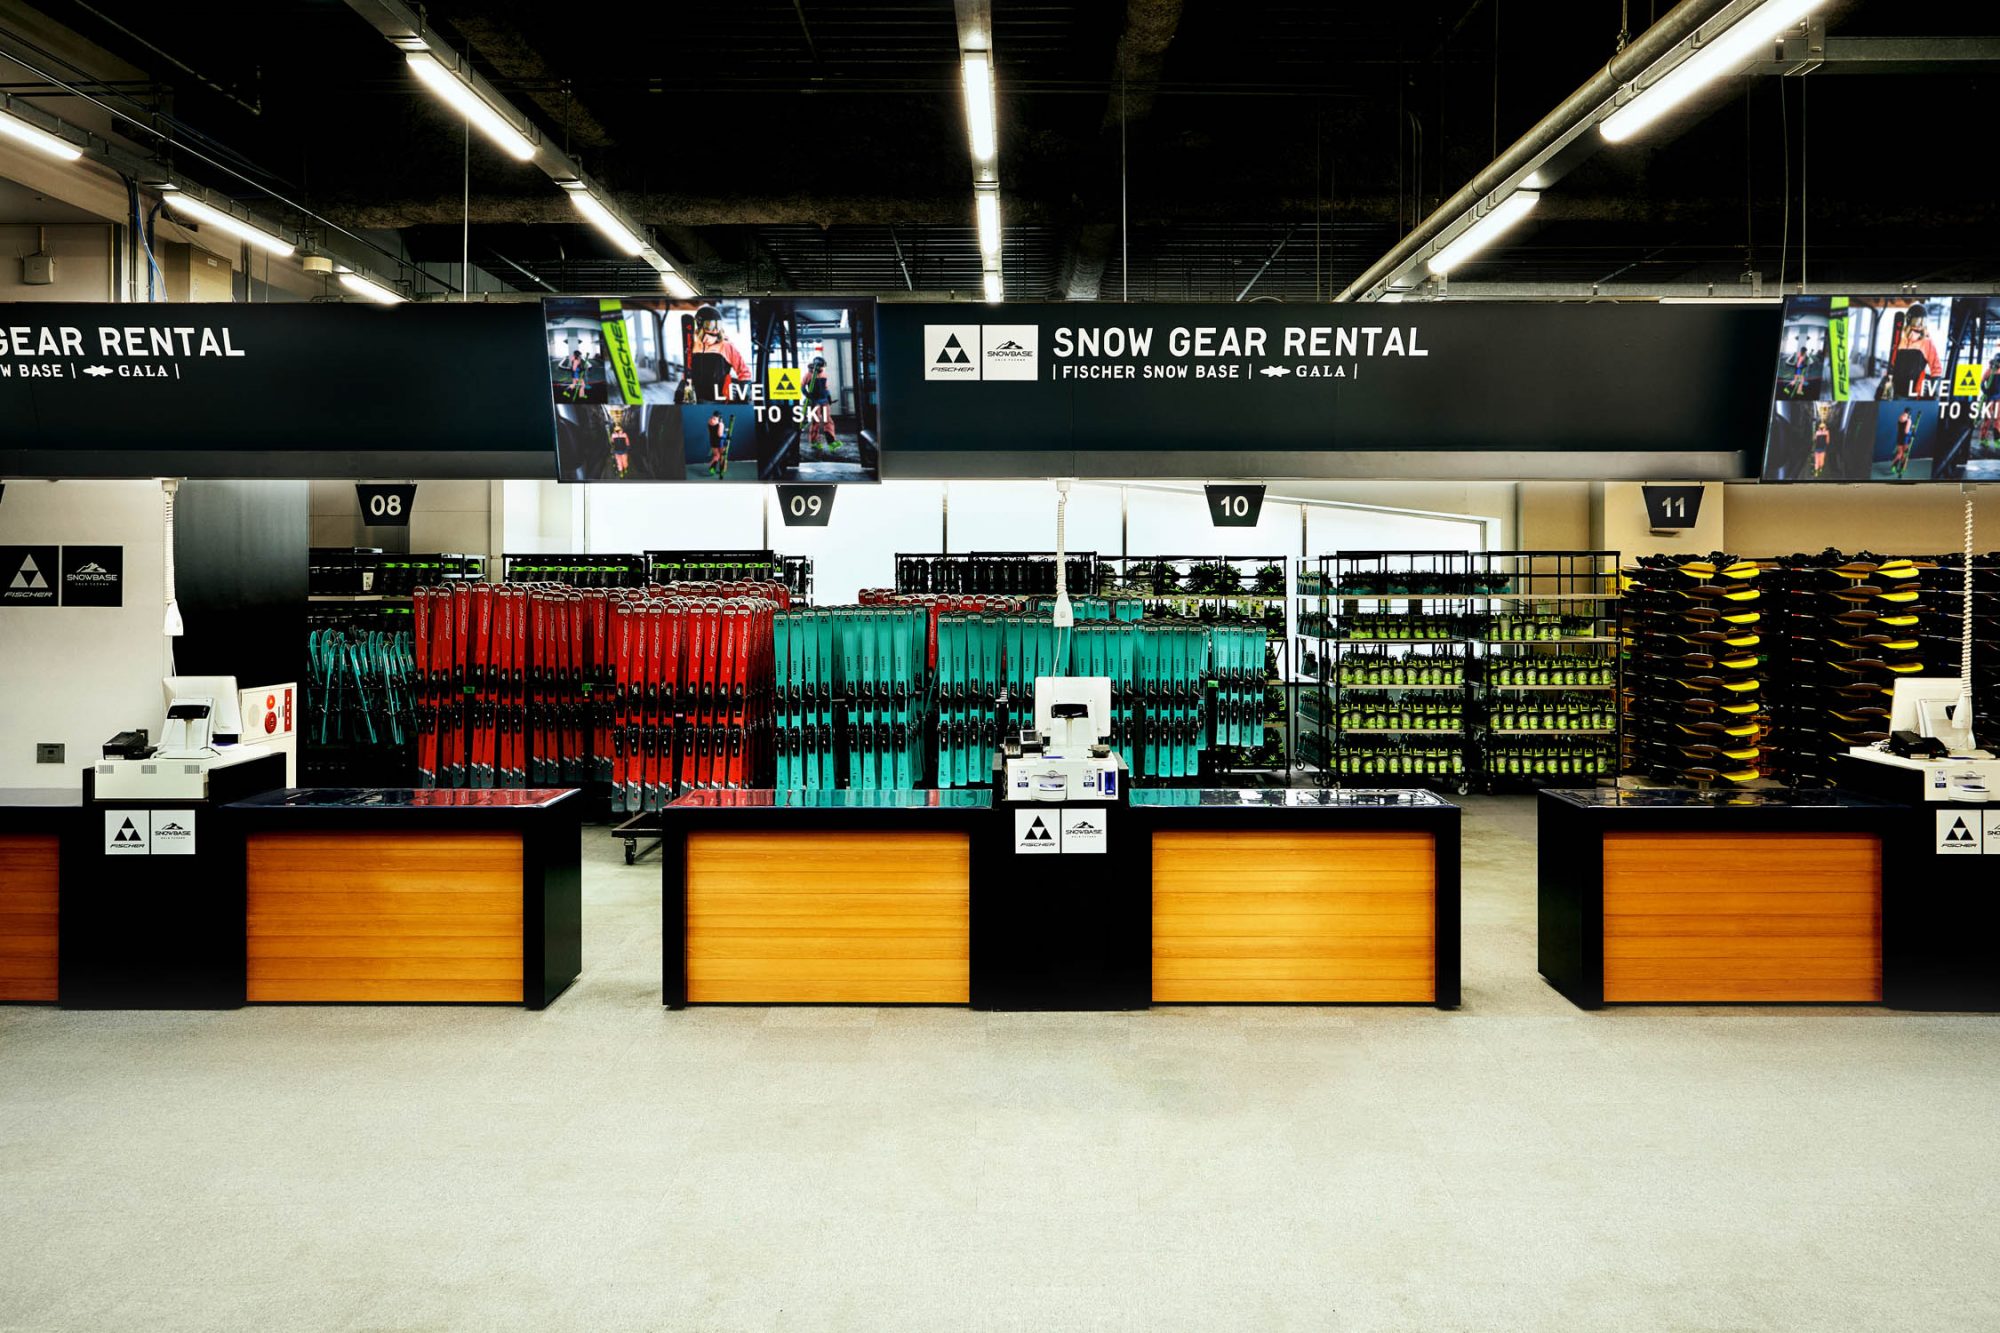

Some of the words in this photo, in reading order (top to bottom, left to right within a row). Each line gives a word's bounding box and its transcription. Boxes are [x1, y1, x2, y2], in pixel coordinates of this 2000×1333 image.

[98, 326, 246, 357] RENTAL
[1052, 326, 1154, 358] SNOW
[1168, 326, 1268, 357] GEAR
[1283, 326, 1429, 357] RENTAL
[986, 350, 1033, 358] SNOWBASE
[18, 363, 64, 378] BASE
[118, 364, 169, 377] GALA
[1062, 364, 1136, 379] FISCHER
[1142, 364, 1189, 379] SNOW
[1195, 364, 1240, 379] BASE
[1295, 364, 1346, 378] GALA
[714, 383, 765, 401] LIVE
[1908, 379, 1951, 397] LIVE
[753, 405, 782, 423] TO
[792, 405, 828, 423] SKI
[1938, 401, 1961, 419] TO
[1968, 401, 2000, 420] SKI
[370, 494, 402, 516] 08
[789, 494, 824, 516] 09
[1220, 495, 1250, 517] 10
[1661, 497, 1685, 518] 11
[66, 573, 118, 581] SNOWBASE
